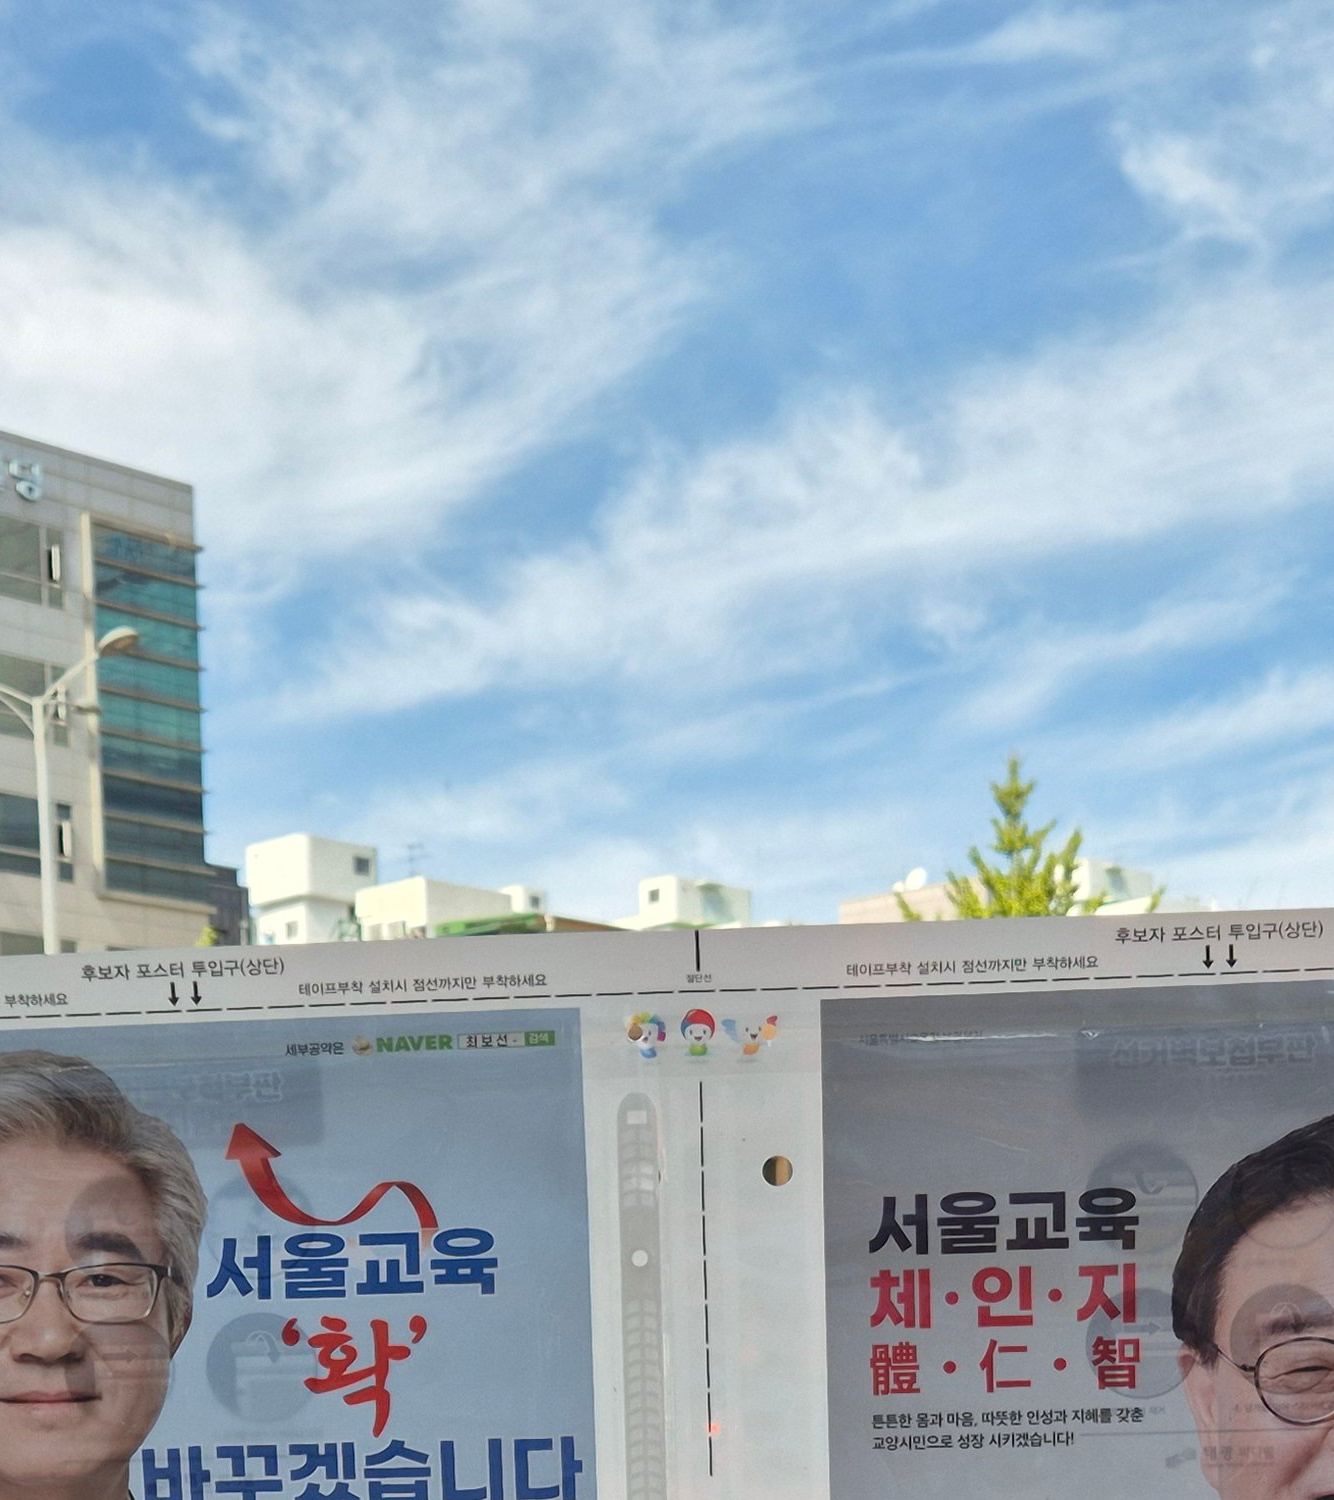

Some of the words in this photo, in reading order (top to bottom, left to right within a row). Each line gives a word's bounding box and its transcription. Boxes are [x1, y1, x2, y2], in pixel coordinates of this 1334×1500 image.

[1115, 927, 1165, 944] 후보자
[1172, 925, 1220, 941] 포스터
[1229, 921, 1323, 940] 투입구(상단)
[82, 964, 130, 982] 후보자
[137, 962, 184, 978] 포스터
[192, 958, 284, 977] 투입구(상단)
[847, 962, 911, 976] 테이프부착
[917, 961, 955, 975] 설치시
[963, 958, 1026, 973] 점선까지만
[1033, 956, 1098, 970] 부착하세요
[299, 981, 363, 996] 테이프부착
[369, 979, 407, 993] 설치시
[413, 977, 476, 991] 점선까지만
[483, 974, 547, 988] 부착하세요
[285, 1041, 344, 1056] 세부공약은
[376, 1035, 453, 1053] NAVER
[466, 1034, 509, 1048] 최보선
[527, 1032, 550, 1046] 검색
[869, 1188, 1139, 1255] 서울교육
[206, 1227, 498, 1301] 서울교육
[871, 1413, 912, 1428] 튼튼한
[915, 1412, 943, 1427] 몸과
[946, 1412, 978, 1427] 마음,
[981, 1410, 1022, 1426] 따뜻한
[1027, 1410, 1068, 1426] 인성과
[1071, 1408, 1113, 1424] 지혜를
[1116, 1407, 1144, 1423] 갖춘
[872, 1435, 953, 1450] 교양시민으로
[957, 1434, 984, 1449] 성장
[989, 1432, 1074, 1448] 시키겠습니다!
